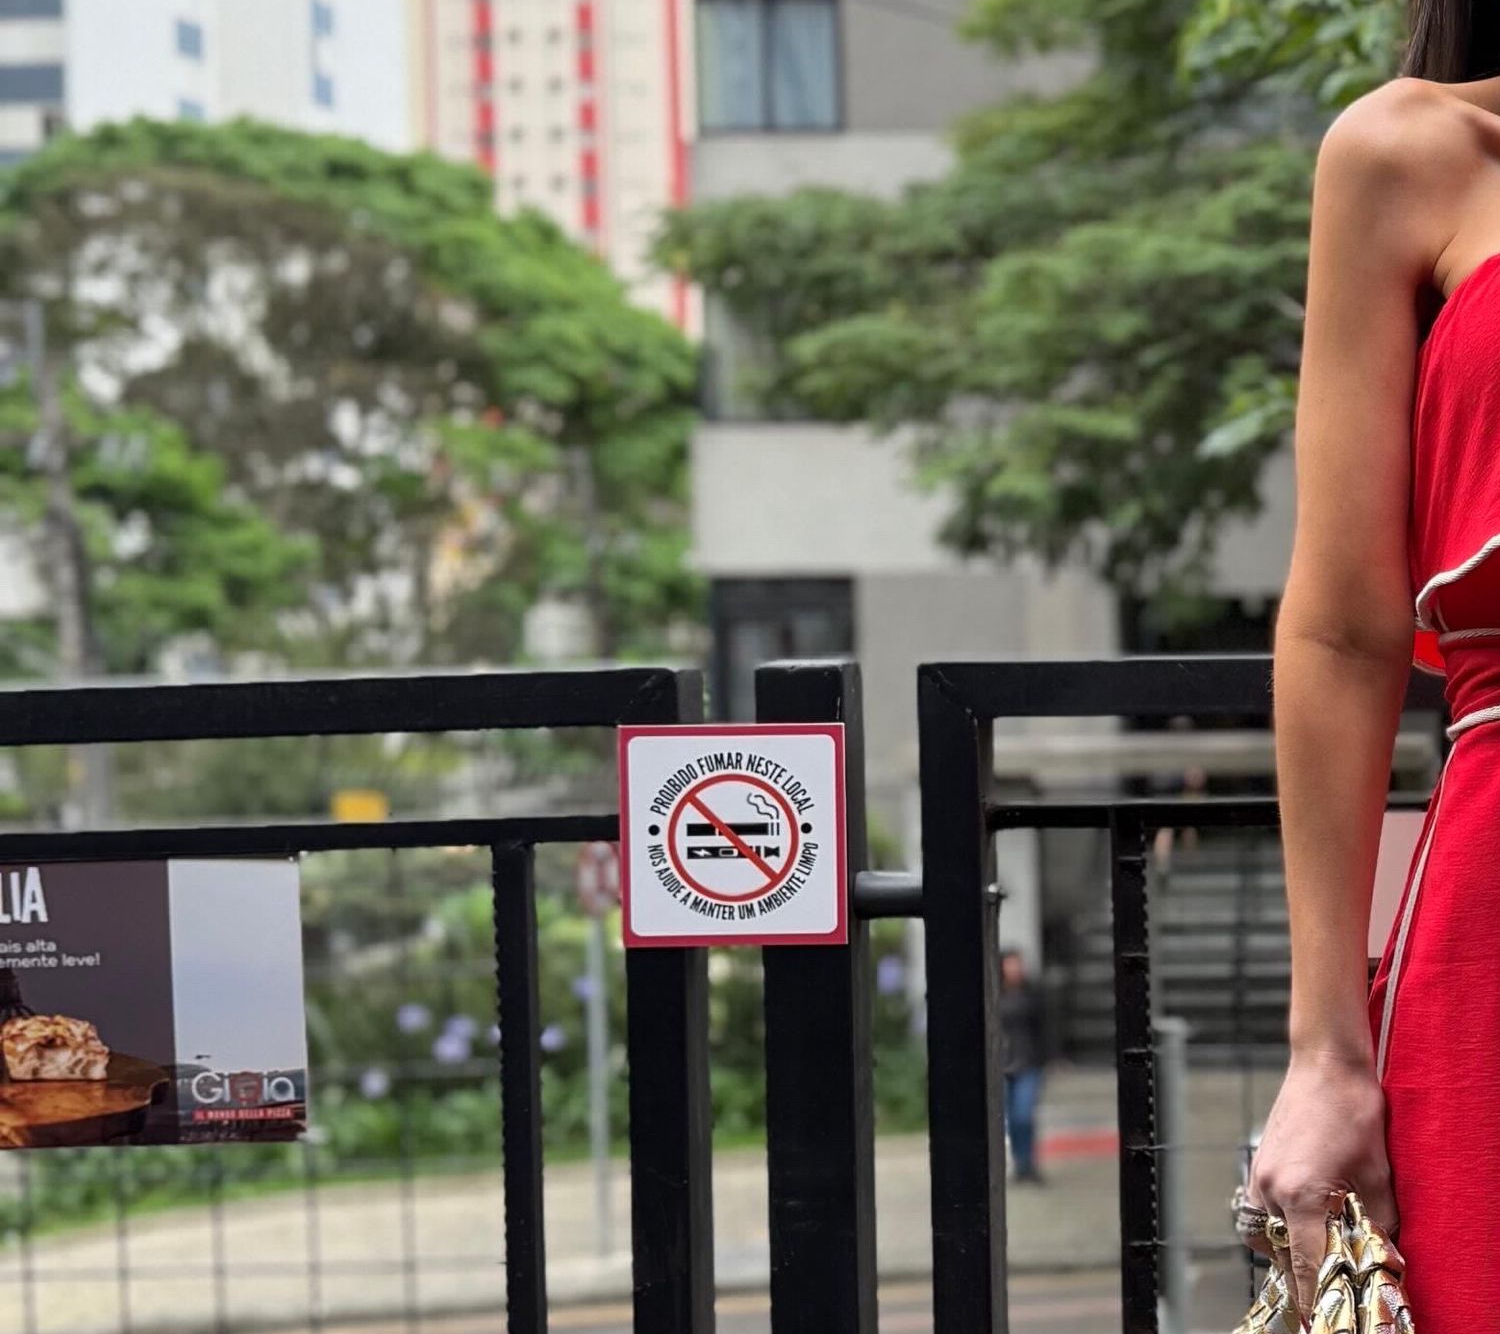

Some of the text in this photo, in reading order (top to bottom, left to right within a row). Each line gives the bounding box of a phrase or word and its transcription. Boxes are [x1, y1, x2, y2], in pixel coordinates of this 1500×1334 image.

[650, 752, 816, 817] PROIBIDO FUMAR NESTE LOCAL
[647, 842, 819, 921] NOS AJUDE A MANTER UM AMBIENTE LIMPO
[25, 938, 57, 953] alta
[61, 952, 101, 966] leve!
